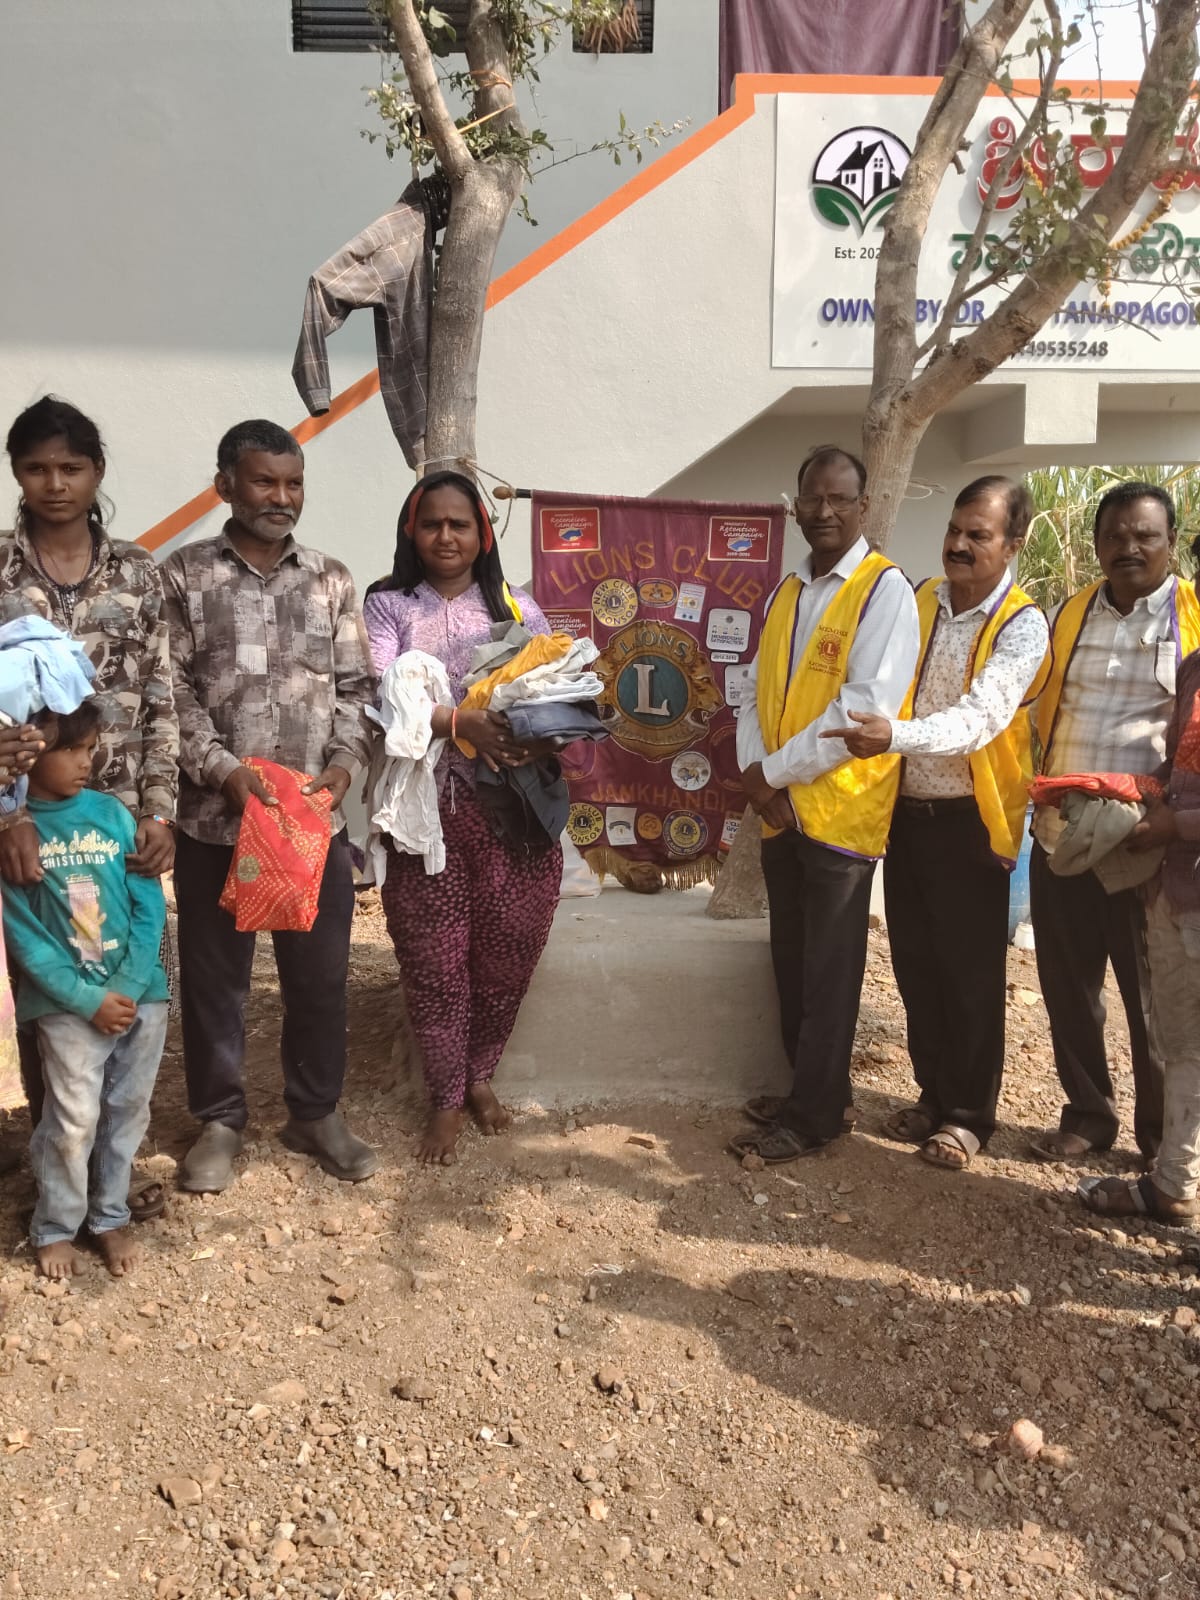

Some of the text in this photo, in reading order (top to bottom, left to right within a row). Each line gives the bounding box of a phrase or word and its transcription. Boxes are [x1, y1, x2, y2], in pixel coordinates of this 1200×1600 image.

[834, 247, 882, 259] Est: 202
[822, 298, 876, 322] OWN
[915, 299, 942, 322] BY
[955, 300, 985, 323] DR
[1022, 340, 1108, 357] 49535248
[550, 542, 655, 596] LIONS
[672, 545, 764, 609] CLUB
[593, 582, 609, 605] NEW
[613, 580, 636, 600] CLUB
[595, 604, 637, 625] SPONSOR
[619, 628, 690, 658] LIONS
[632, 663, 671, 717] L
[581, 804, 603, 822] CLUB
